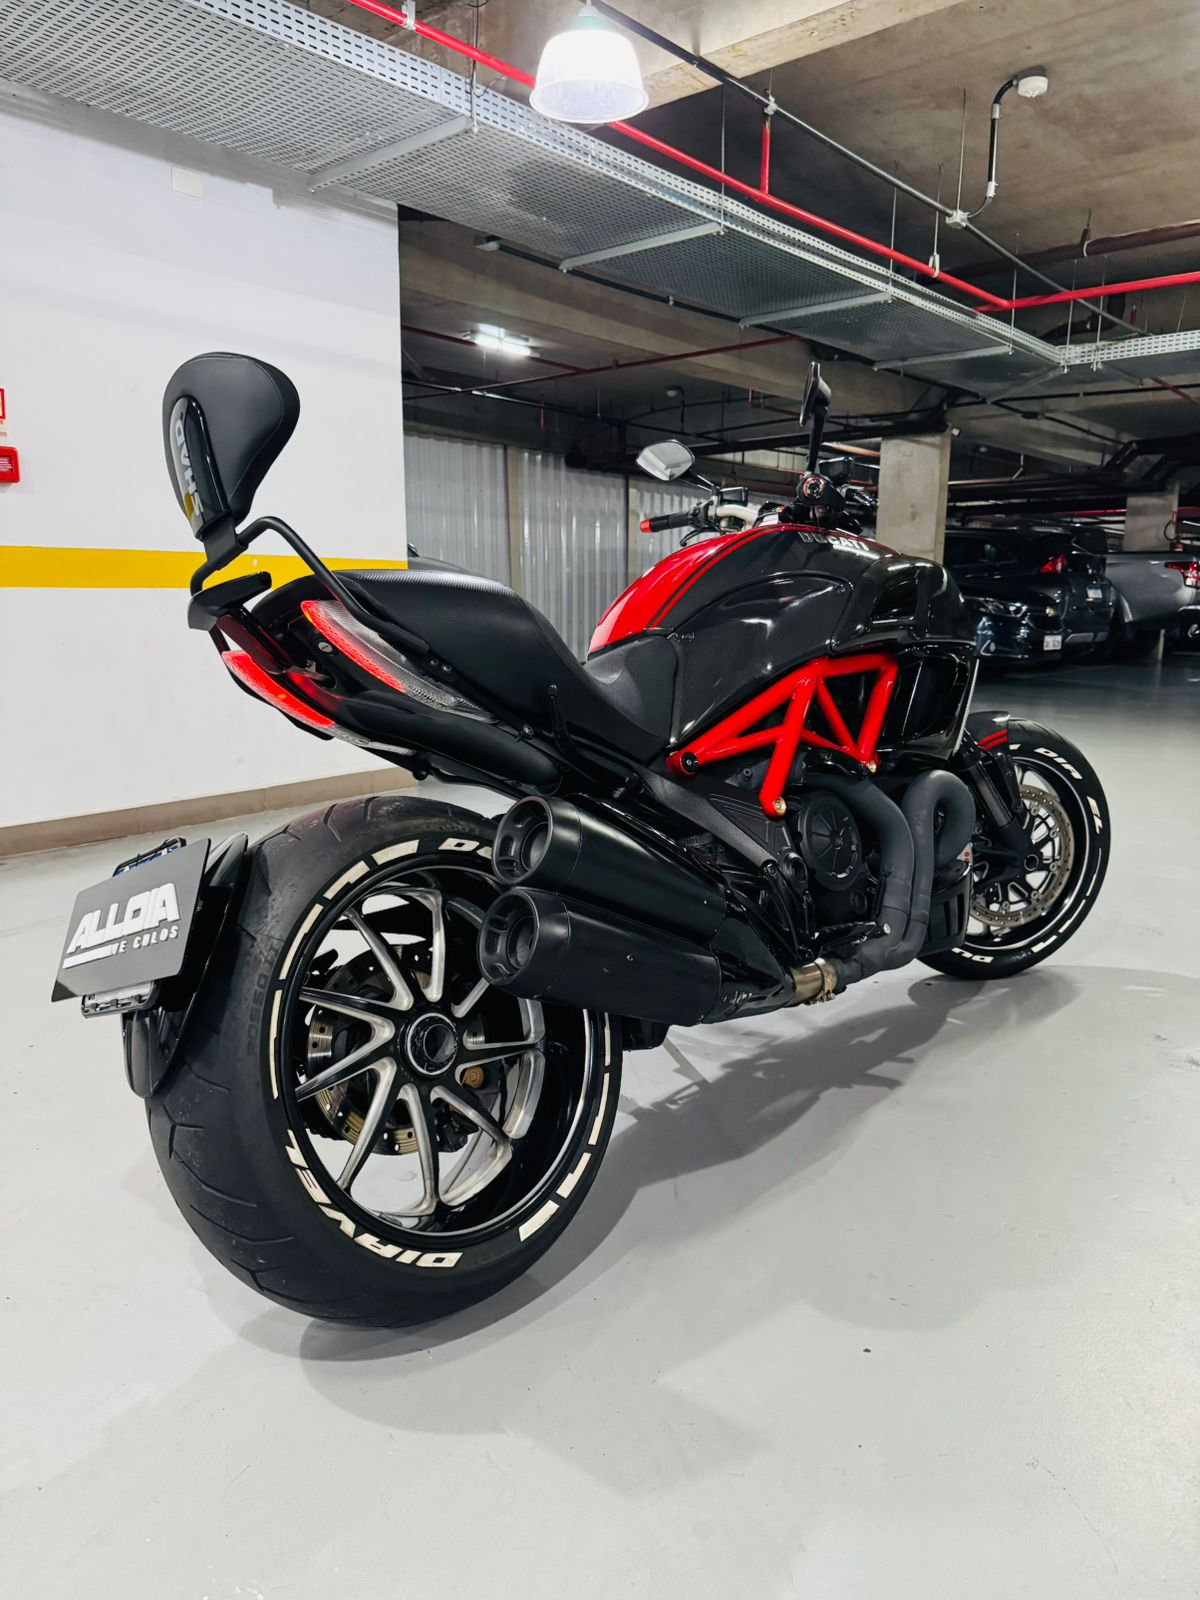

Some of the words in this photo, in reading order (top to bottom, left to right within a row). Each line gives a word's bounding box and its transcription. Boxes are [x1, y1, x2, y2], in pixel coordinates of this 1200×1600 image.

[175, 419, 204, 516] SHAD
[798, 531, 870, 551] DUCATI
[285, 1129, 464, 1268] DIAVEL
